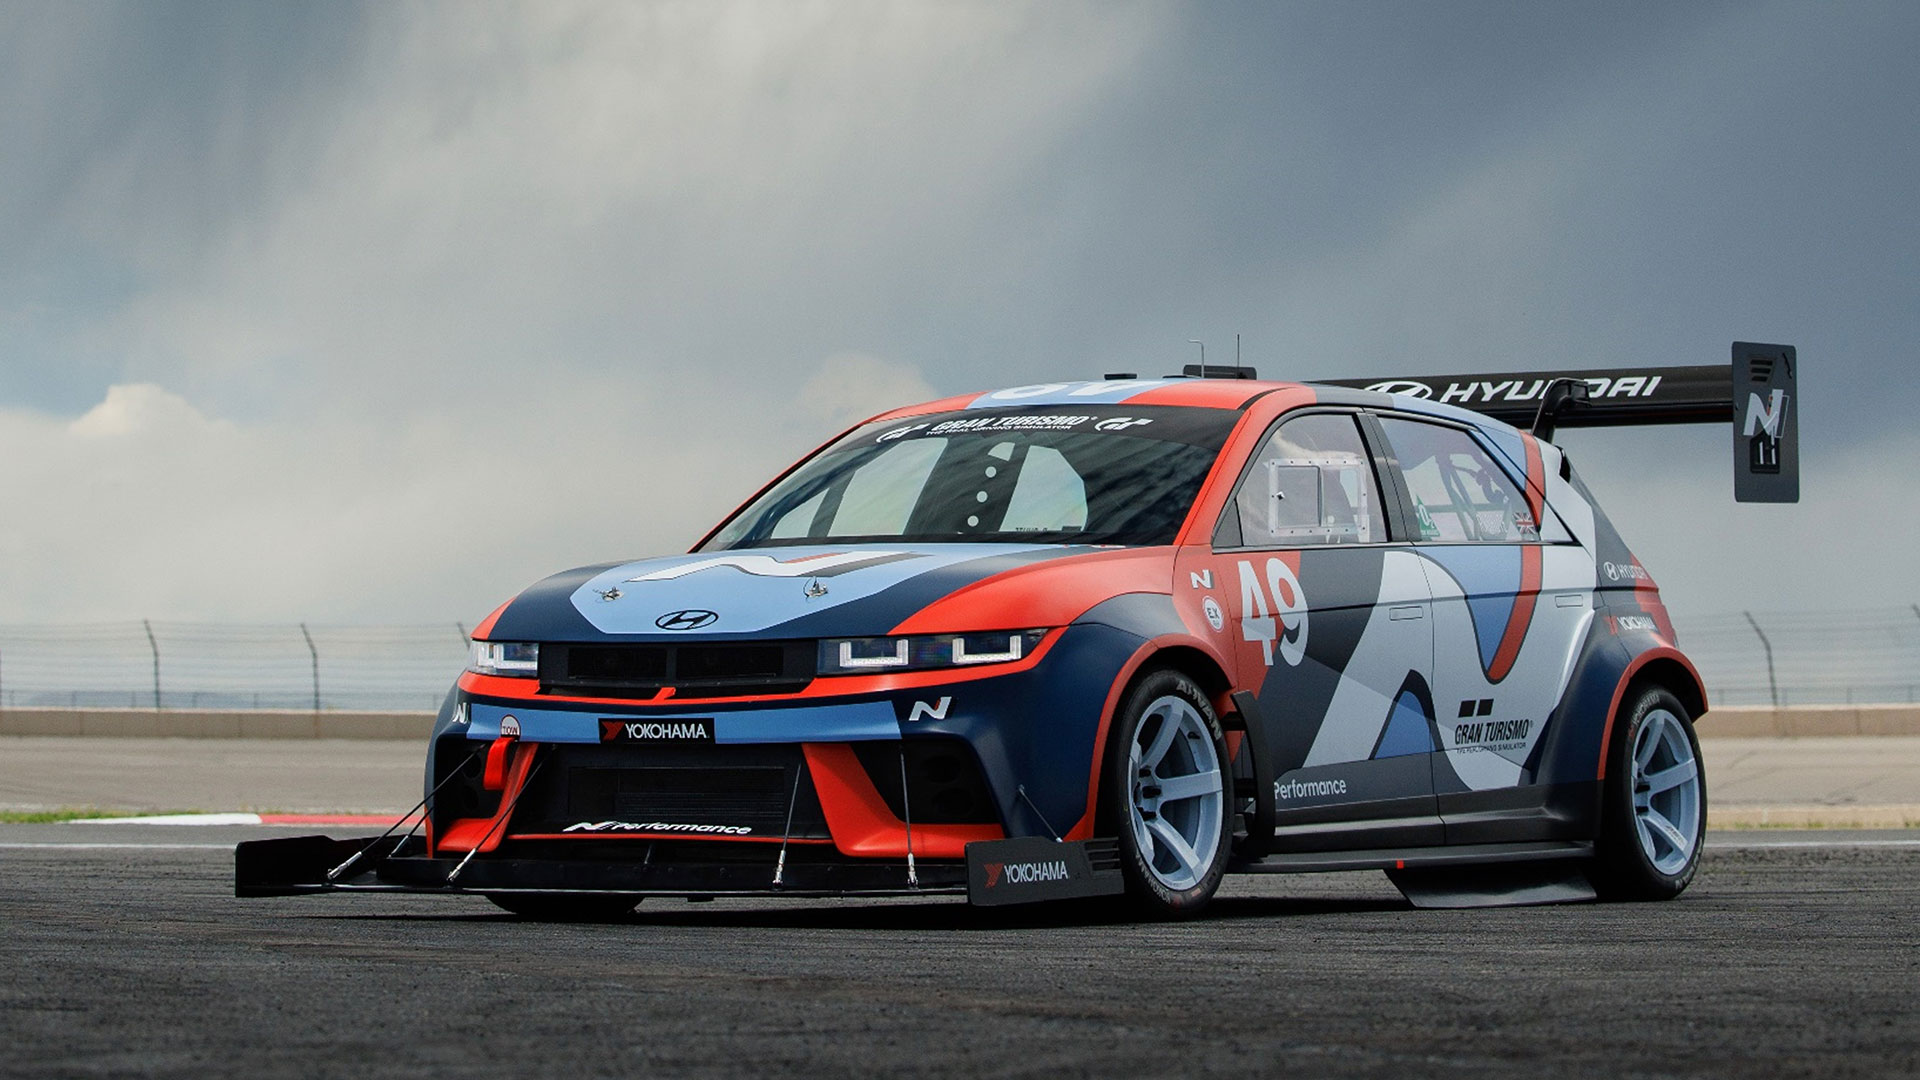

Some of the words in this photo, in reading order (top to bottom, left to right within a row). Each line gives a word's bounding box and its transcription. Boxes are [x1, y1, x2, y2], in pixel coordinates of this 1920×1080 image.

[1440, 376, 1662, 402] HYUDAI
[931, 417, 997, 431] GRAN
[1190, 569, 1214, 589] N
[1237, 557, 1309, 667] 49
[452, 702, 470, 725] N
[909, 696, 952, 721] N
[502, 726, 519, 735] TOW
[624, 723, 708, 739] YOKOHAMA
[1455, 723, 1483, 745] GRAN
[1273, 778, 1347, 800] Performance
[563, 821, 617, 832] N
[611, 822, 752, 835] Performance
[1004, 861, 1069, 883] YOKOHAMA
